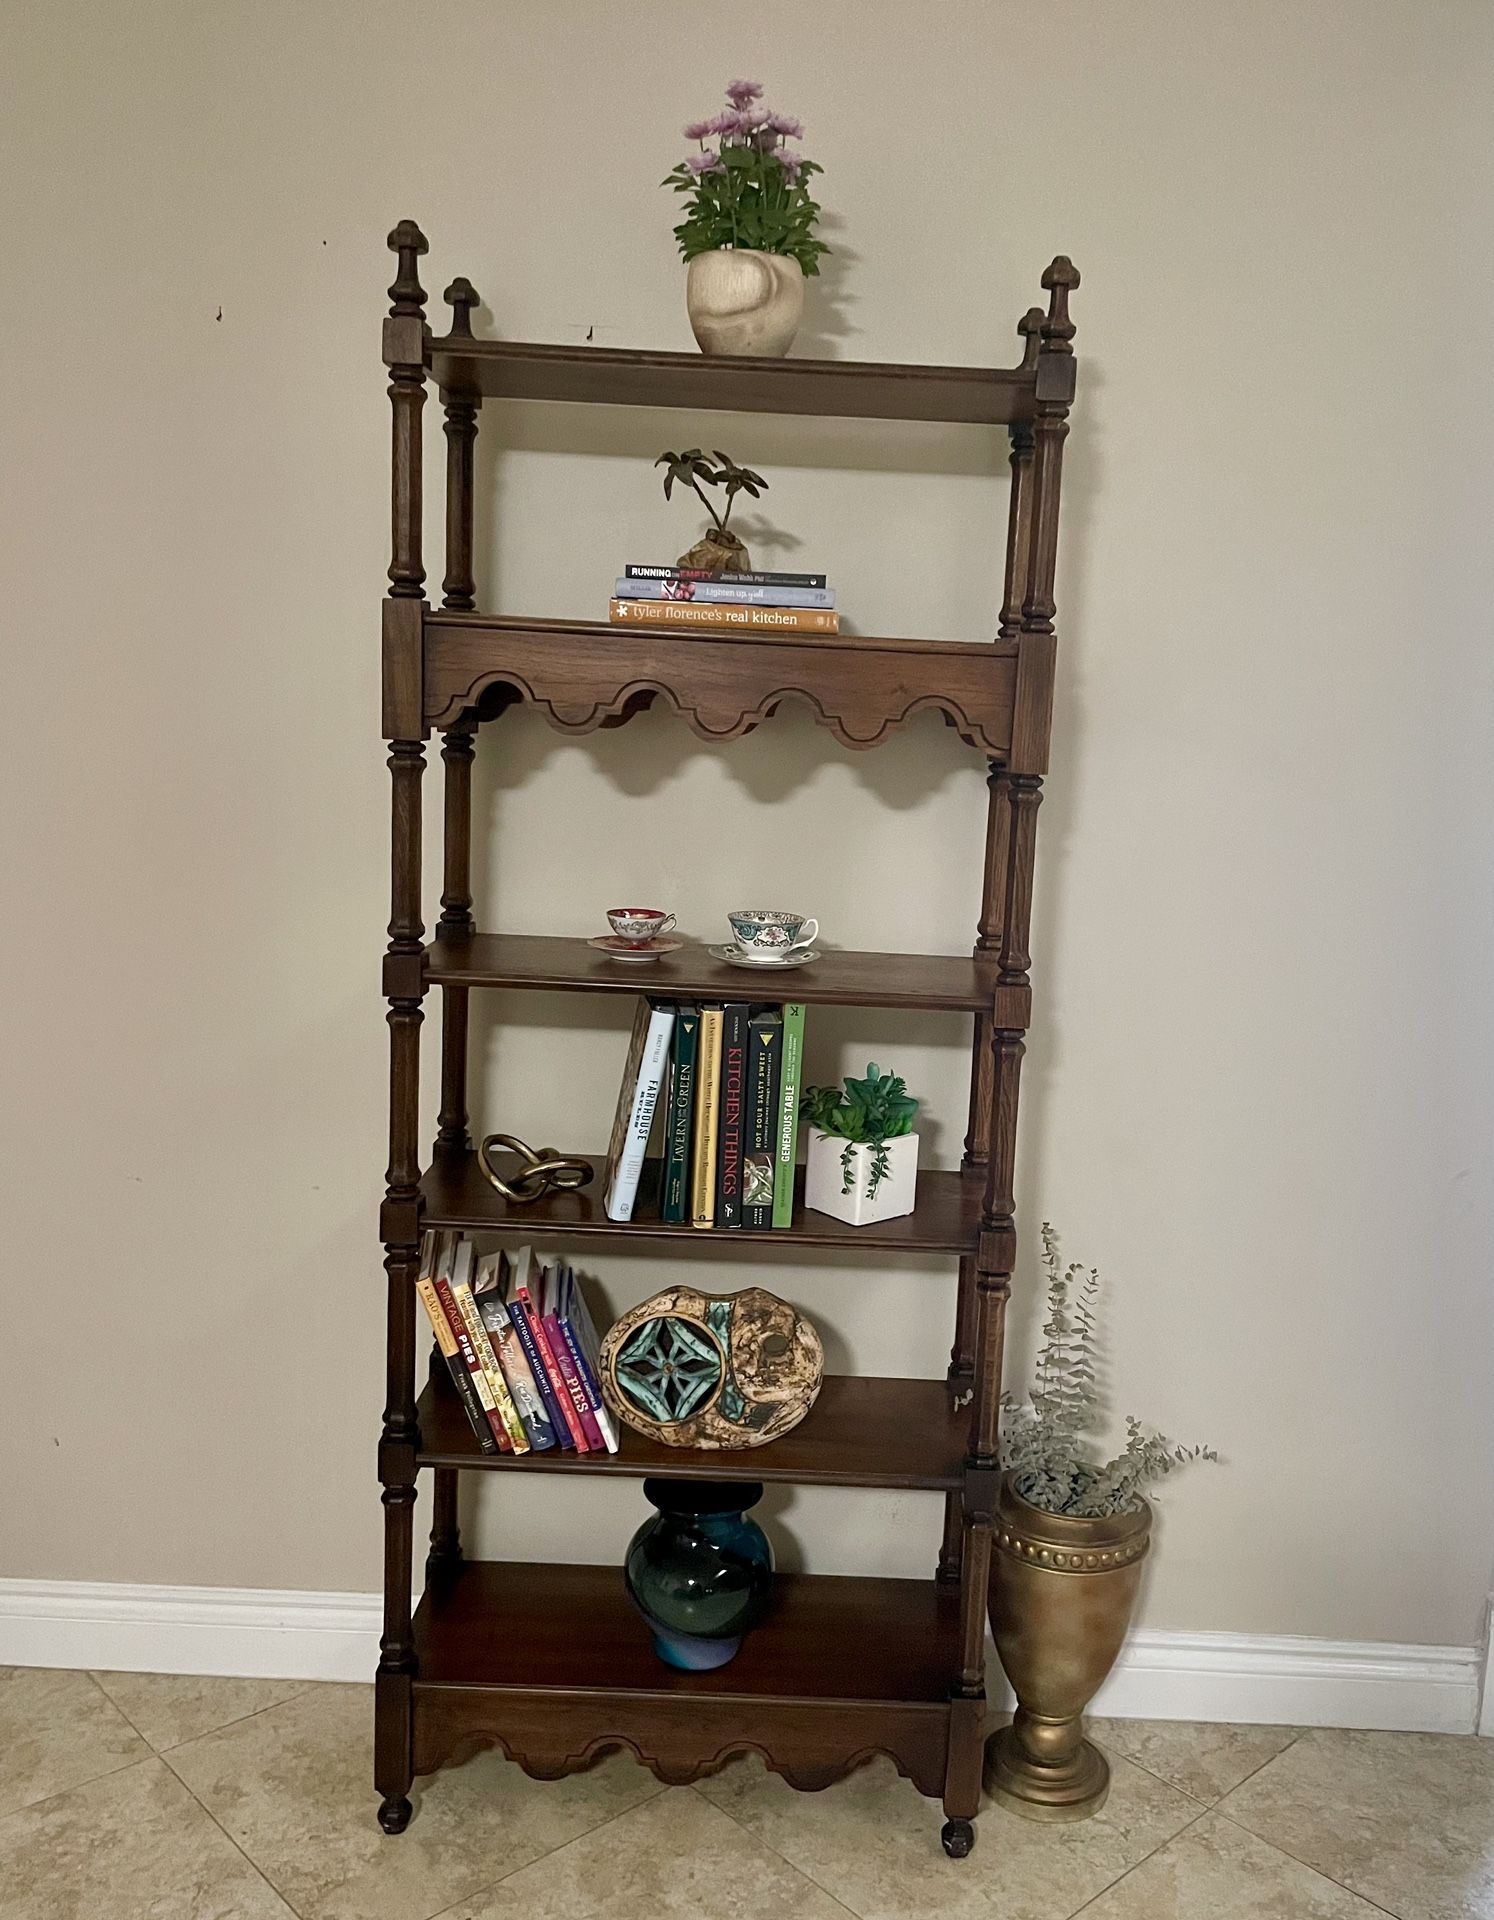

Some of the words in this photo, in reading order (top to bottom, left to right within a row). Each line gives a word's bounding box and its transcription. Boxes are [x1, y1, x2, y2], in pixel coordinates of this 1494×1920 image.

[631, 567, 671, 578] RUNNING
[680, 569, 712, 579] EMPTY
[705, 587, 735, 598] Lighten
[633, 605, 662, 618] tyler
[665, 607, 722, 620] florence's
[726, 610, 748, 622] real
[752, 612, 797, 624] kitchen
[790, 1005, 799, 1016] K
[676, 1063, 690, 1107] GREEN
[725, 1047, 741, 1124] KITCHEN
[784, 1084, 794, 1113] TABLE
[637, 1079, 658, 1141] FARMHOUSE
[672, 1117, 686, 1163] TAVERN
[781, 1114, 792, 1161] GENEROUS
[723, 1128, 738, 1194] THINGS
[425, 1292, 442, 1320] RAO'S
[439, 1285, 464, 1332] VINTAGE
[457, 1333, 476, 1364] PIES
[469, 1306, 479, 1318] and
[529, 1314, 541, 1334] Classic
[535, 1332, 549, 1355] Cooking
[561, 1327, 570, 1337] THE
[516, 1315, 533, 1349] TATTOOIST
[532, 1357, 550, 1394] AUSCHWITZ
[565, 1374, 589, 1414] PIES
